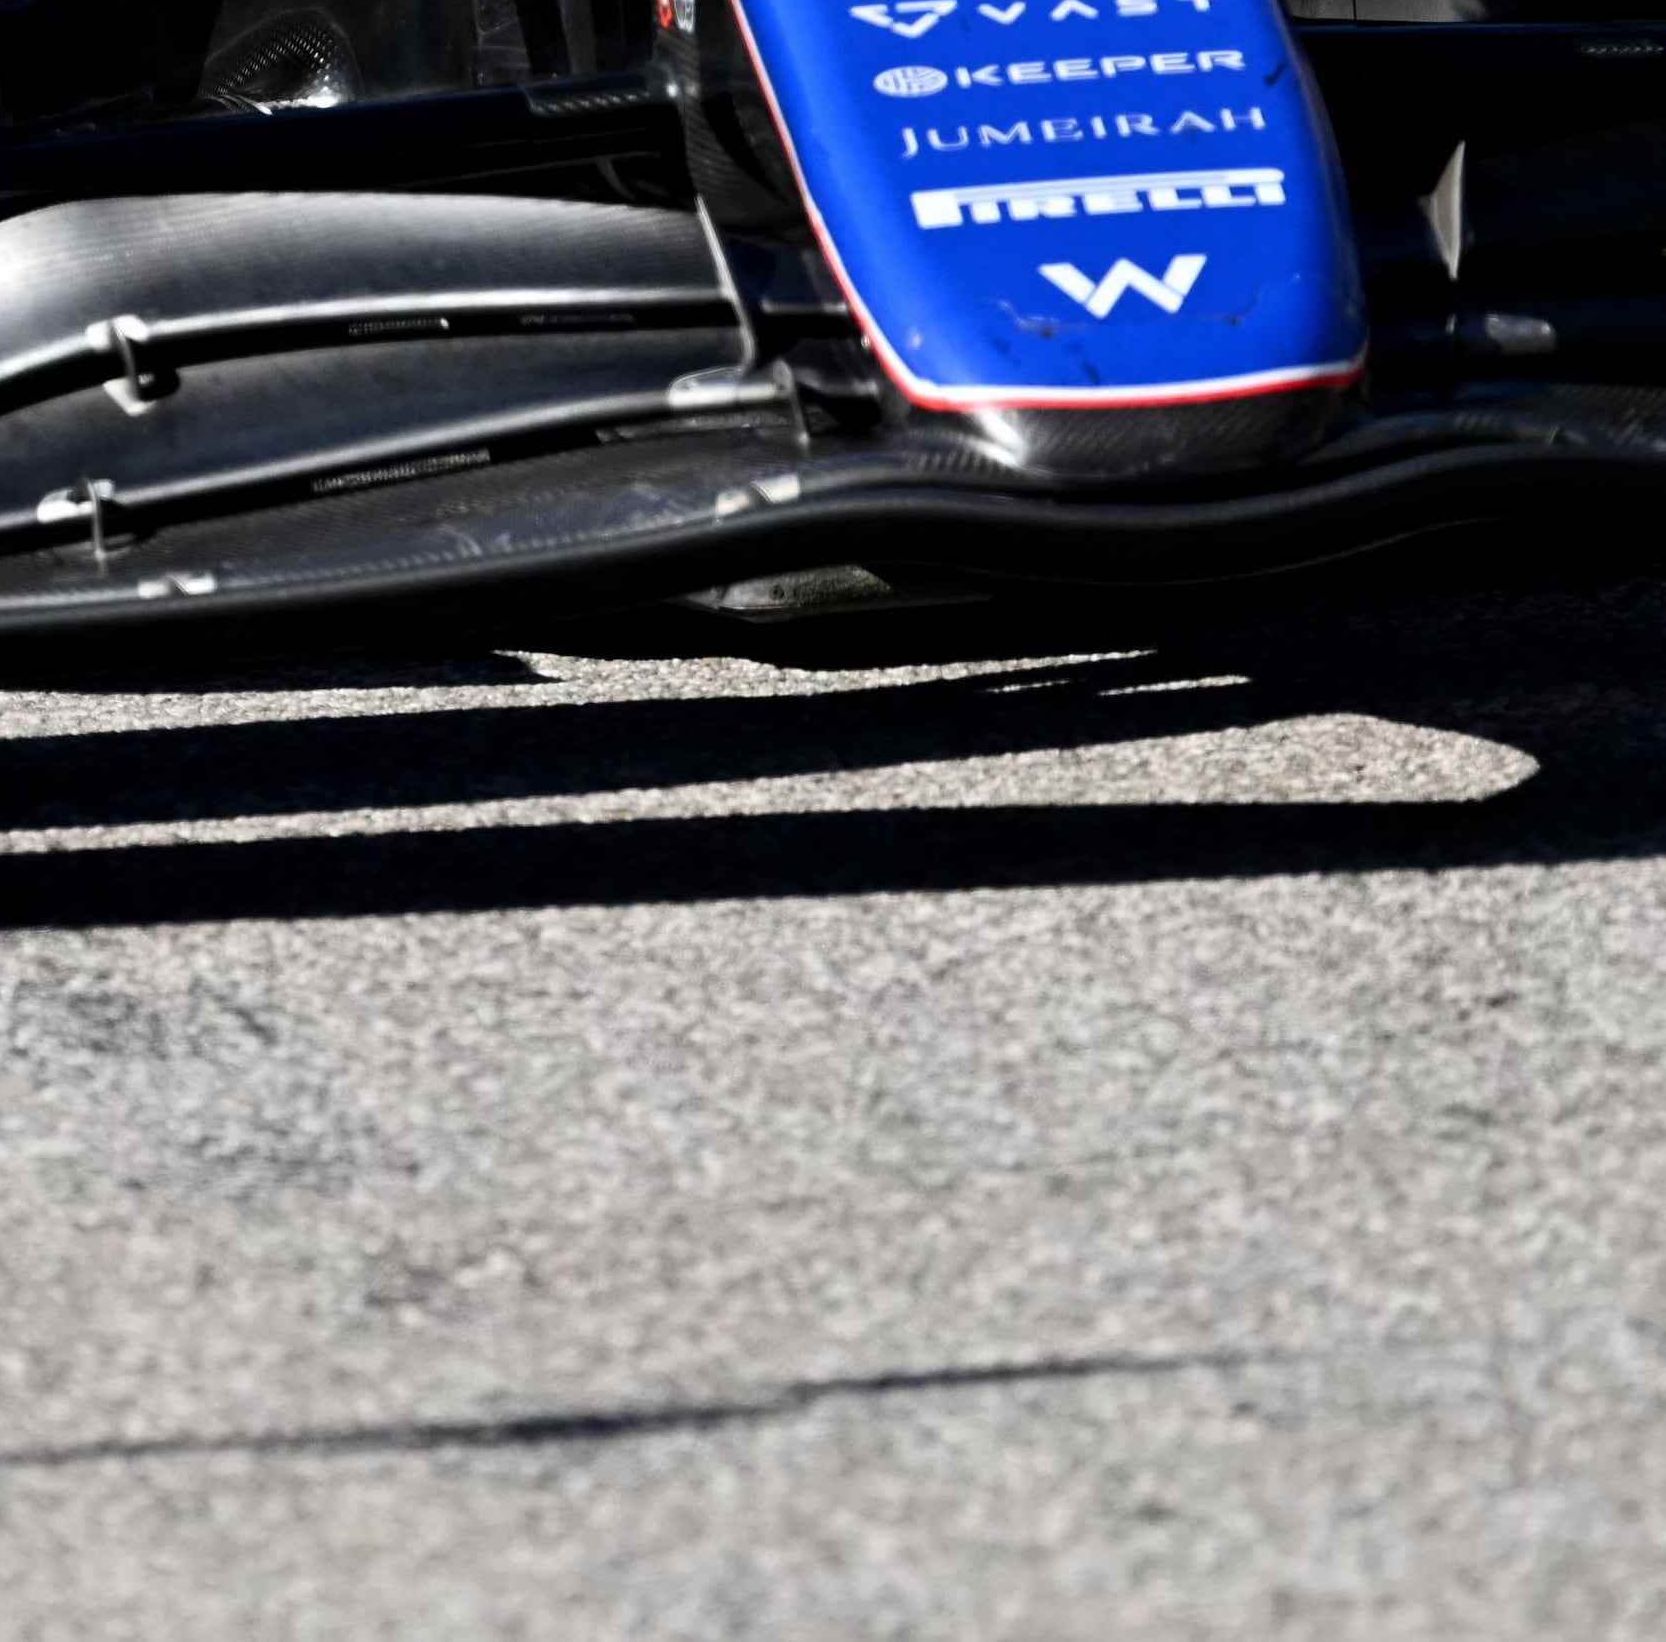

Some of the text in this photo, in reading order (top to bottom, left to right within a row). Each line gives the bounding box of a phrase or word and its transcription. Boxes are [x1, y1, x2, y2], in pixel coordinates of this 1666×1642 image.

[955, 49, 1246, 88] KEEPER
[901, 106, 1266, 159] JUMEIRAH
[910, 167, 1286, 230] PIRELLI
